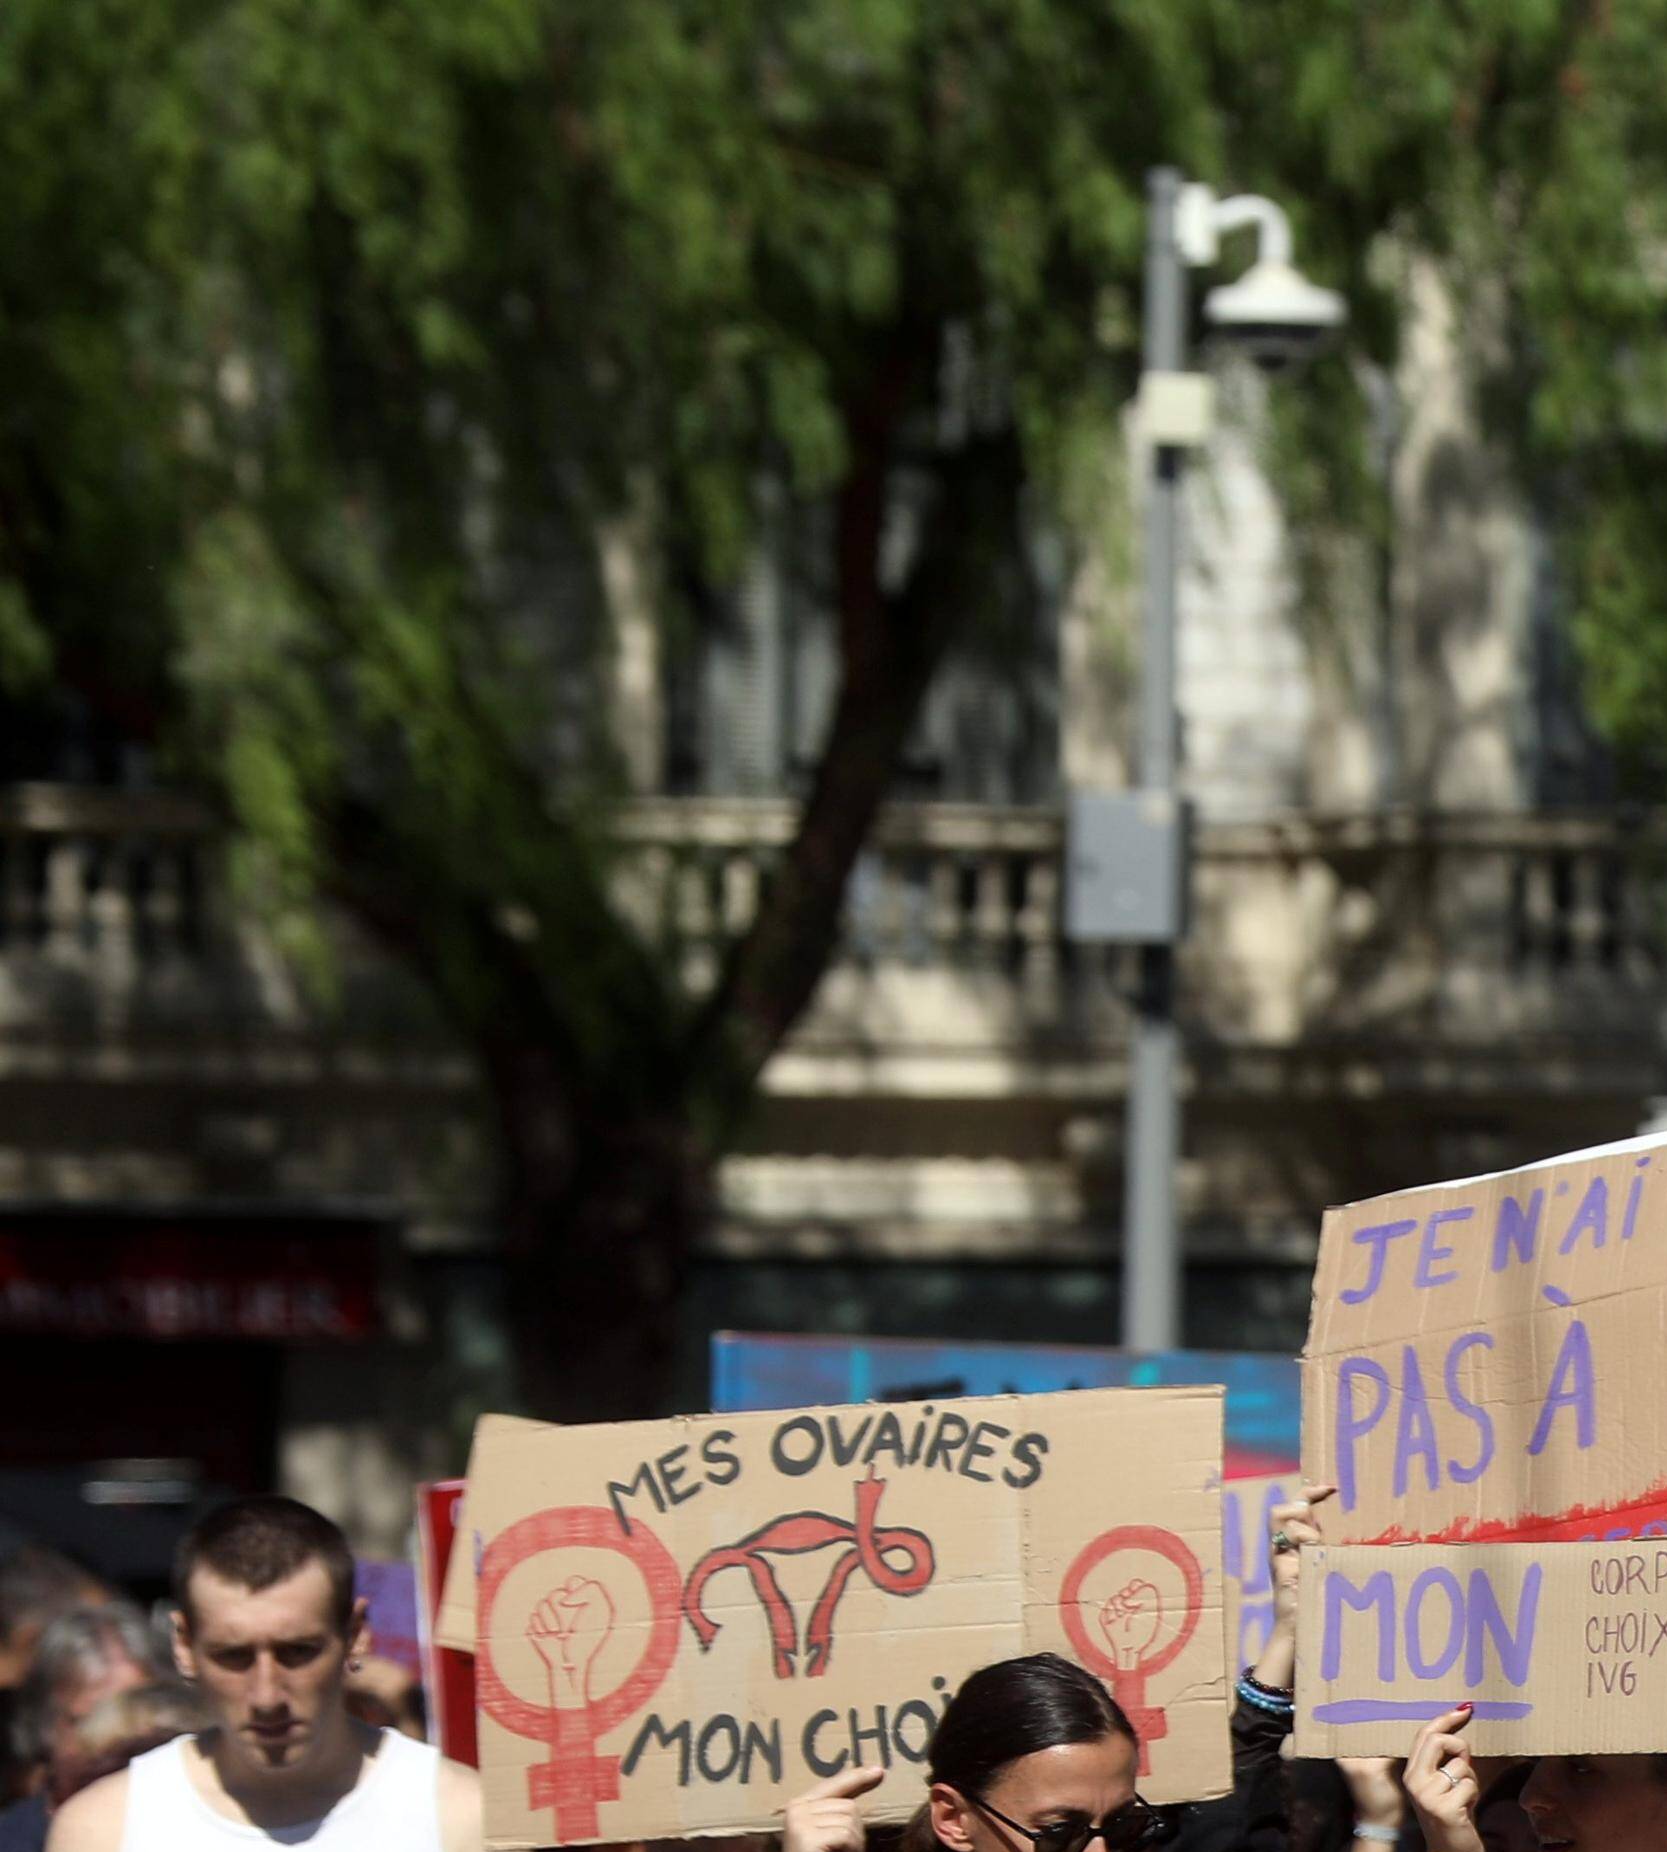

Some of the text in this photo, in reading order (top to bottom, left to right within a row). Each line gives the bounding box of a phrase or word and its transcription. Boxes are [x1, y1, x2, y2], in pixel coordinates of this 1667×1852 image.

[1339, 1206, 1475, 1305] JE
[1336, 1286, 1593, 1514] PAS À
[607, 1430, 742, 1535] MES
[1321, 1562, 1543, 1688] MON
[1587, 1660, 1637, 1698] IVG
[621, 1714, 782, 1787] MON
